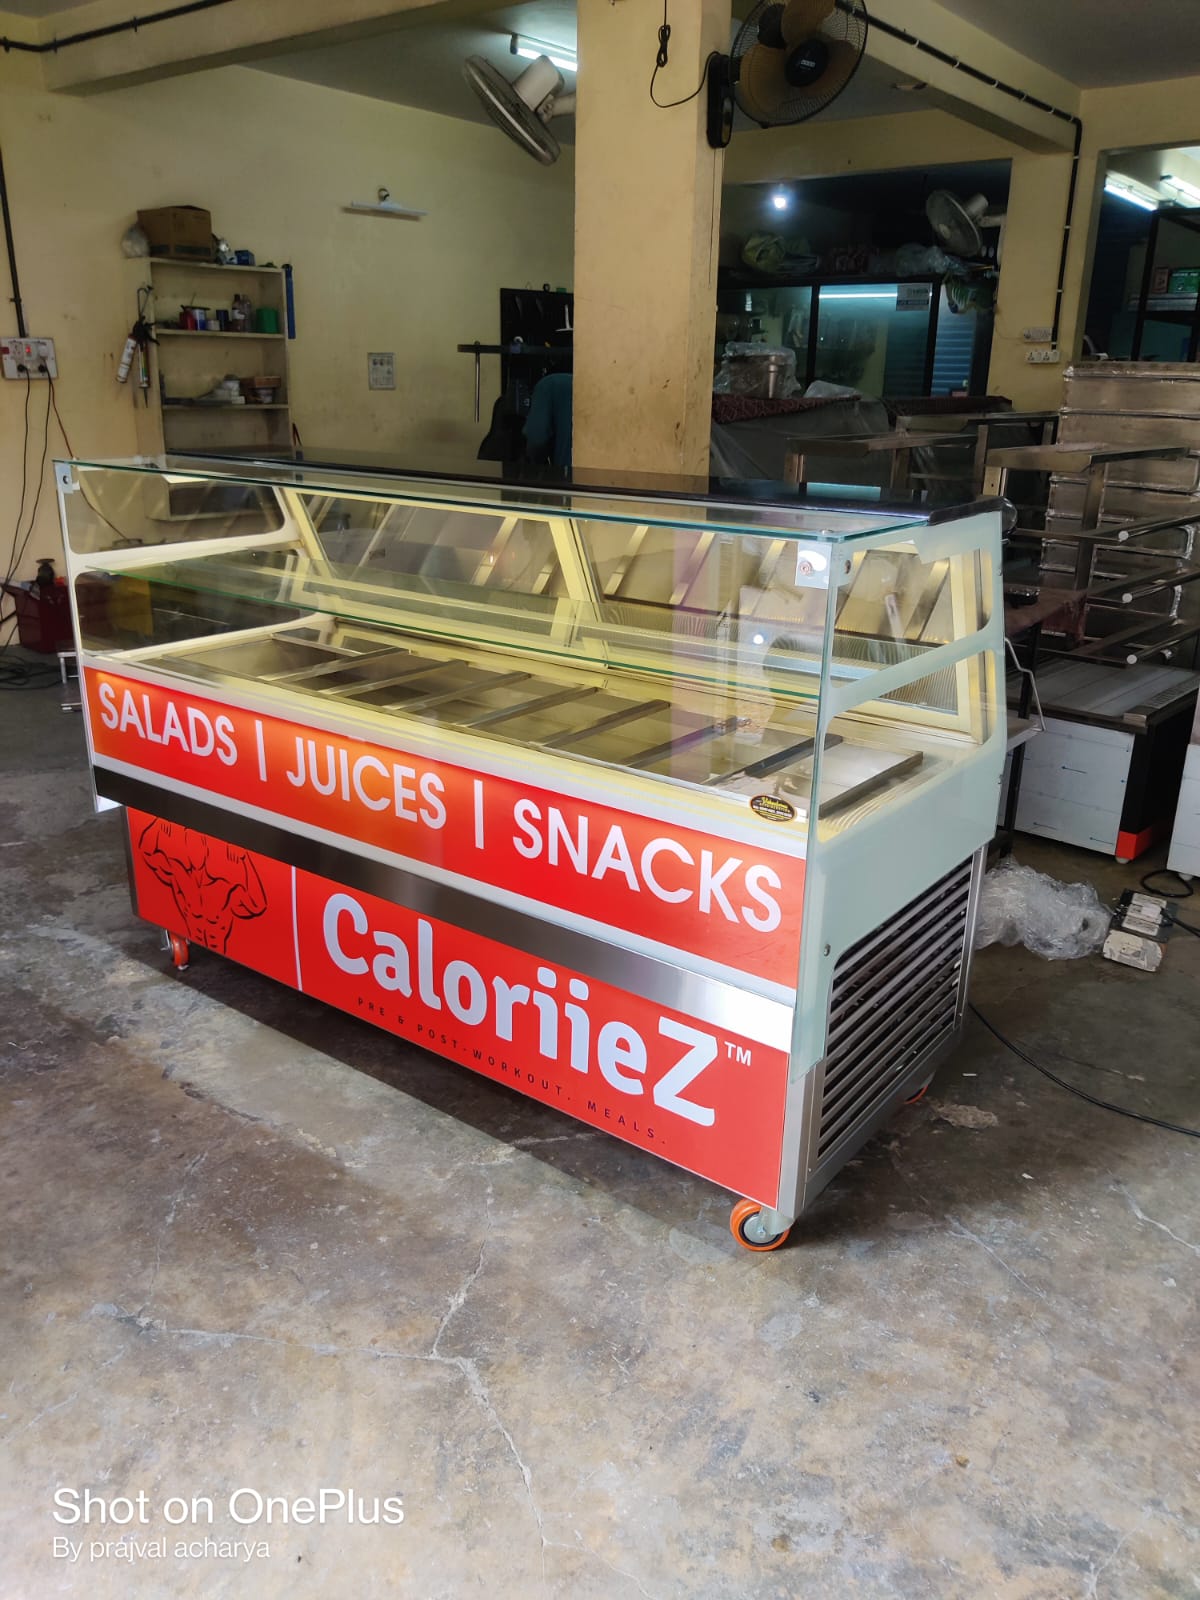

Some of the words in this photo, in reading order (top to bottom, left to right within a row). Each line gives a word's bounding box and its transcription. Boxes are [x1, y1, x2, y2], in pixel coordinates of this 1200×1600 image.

[98, 682, 238, 766] SALADS
[286, 736, 447, 830] JUICES
[512, 798, 785, 933] SNACKS
[323, 893, 719, 1127] CaloriieZ
[358, 996, 385, 1017] PRE
